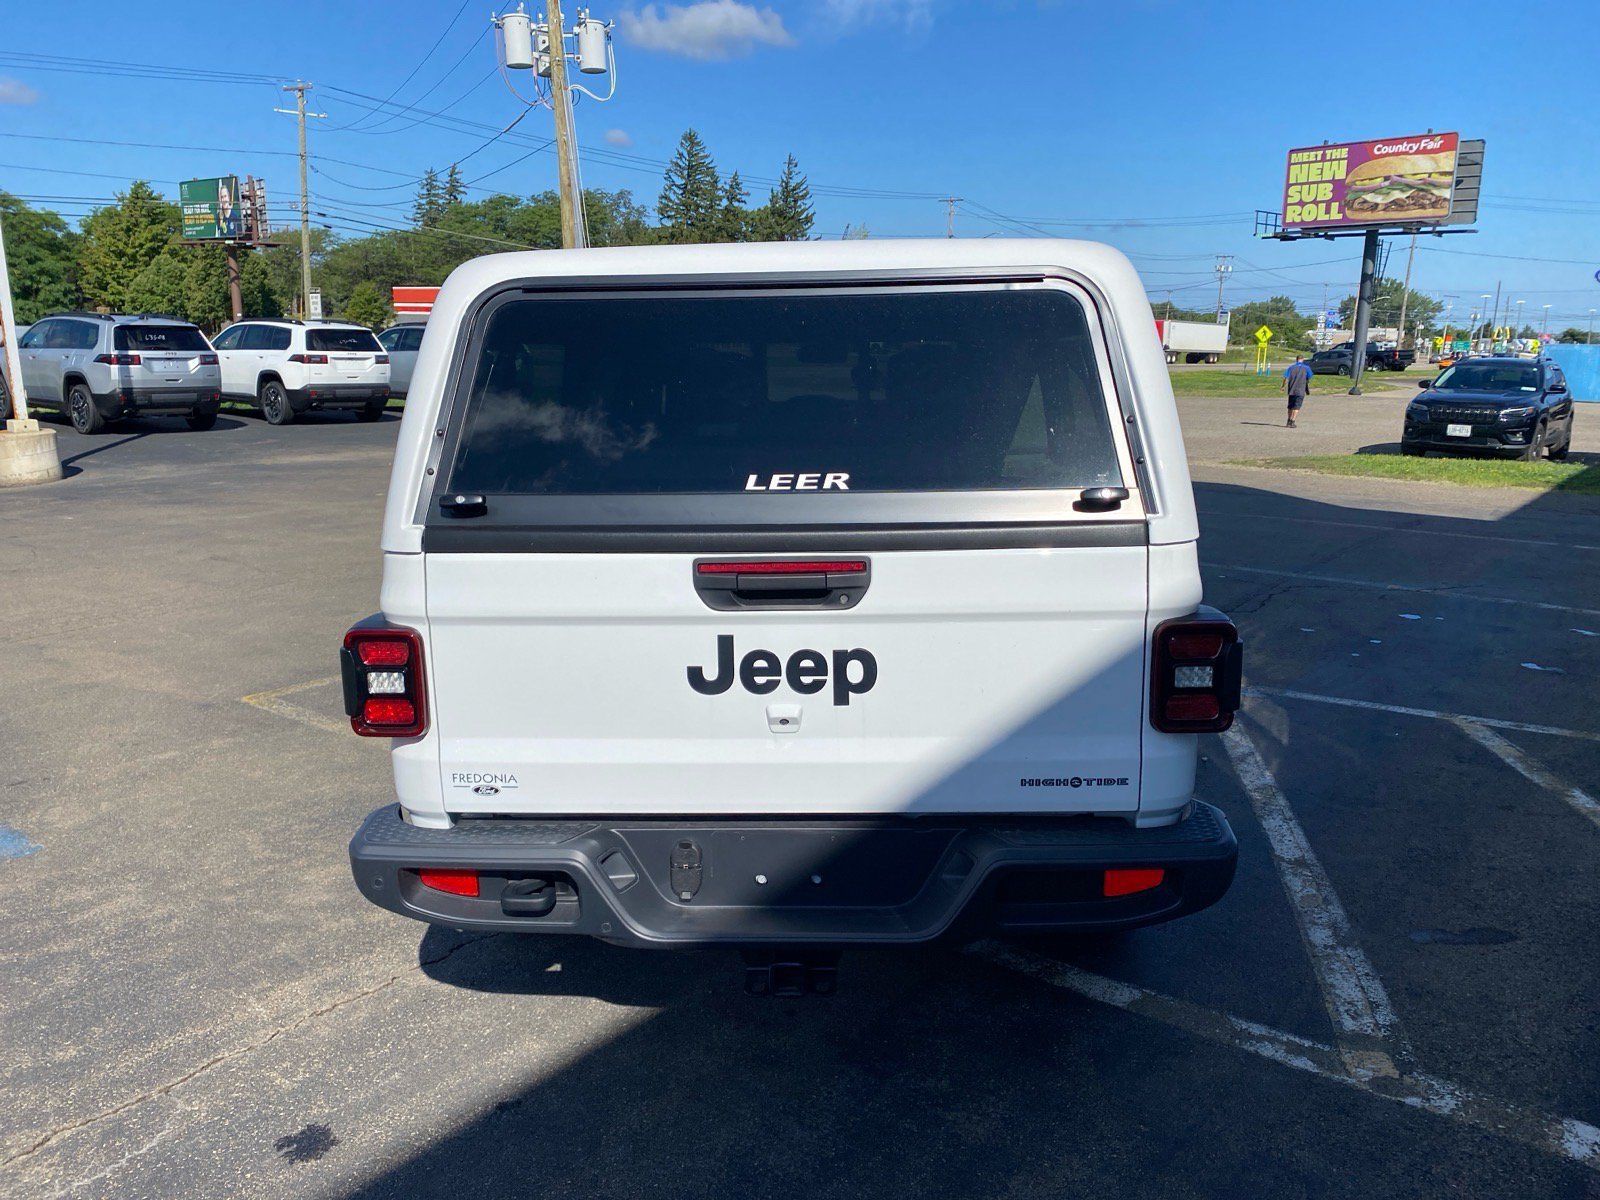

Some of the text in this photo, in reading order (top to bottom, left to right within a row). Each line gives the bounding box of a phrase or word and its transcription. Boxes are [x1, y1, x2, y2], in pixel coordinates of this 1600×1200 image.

[1291, 148, 1349, 163] MEET THE
[1374, 138, 1444, 154] Country Fair
[1289, 160, 1348, 184] NEW
[1287, 183, 1333, 203] SUB
[1286, 202, 1343, 223] ROLL
[744, 472, 850, 491] LEER
[686, 634, 878, 706] Jeep
[452, 773, 518, 784] FREDONIA
